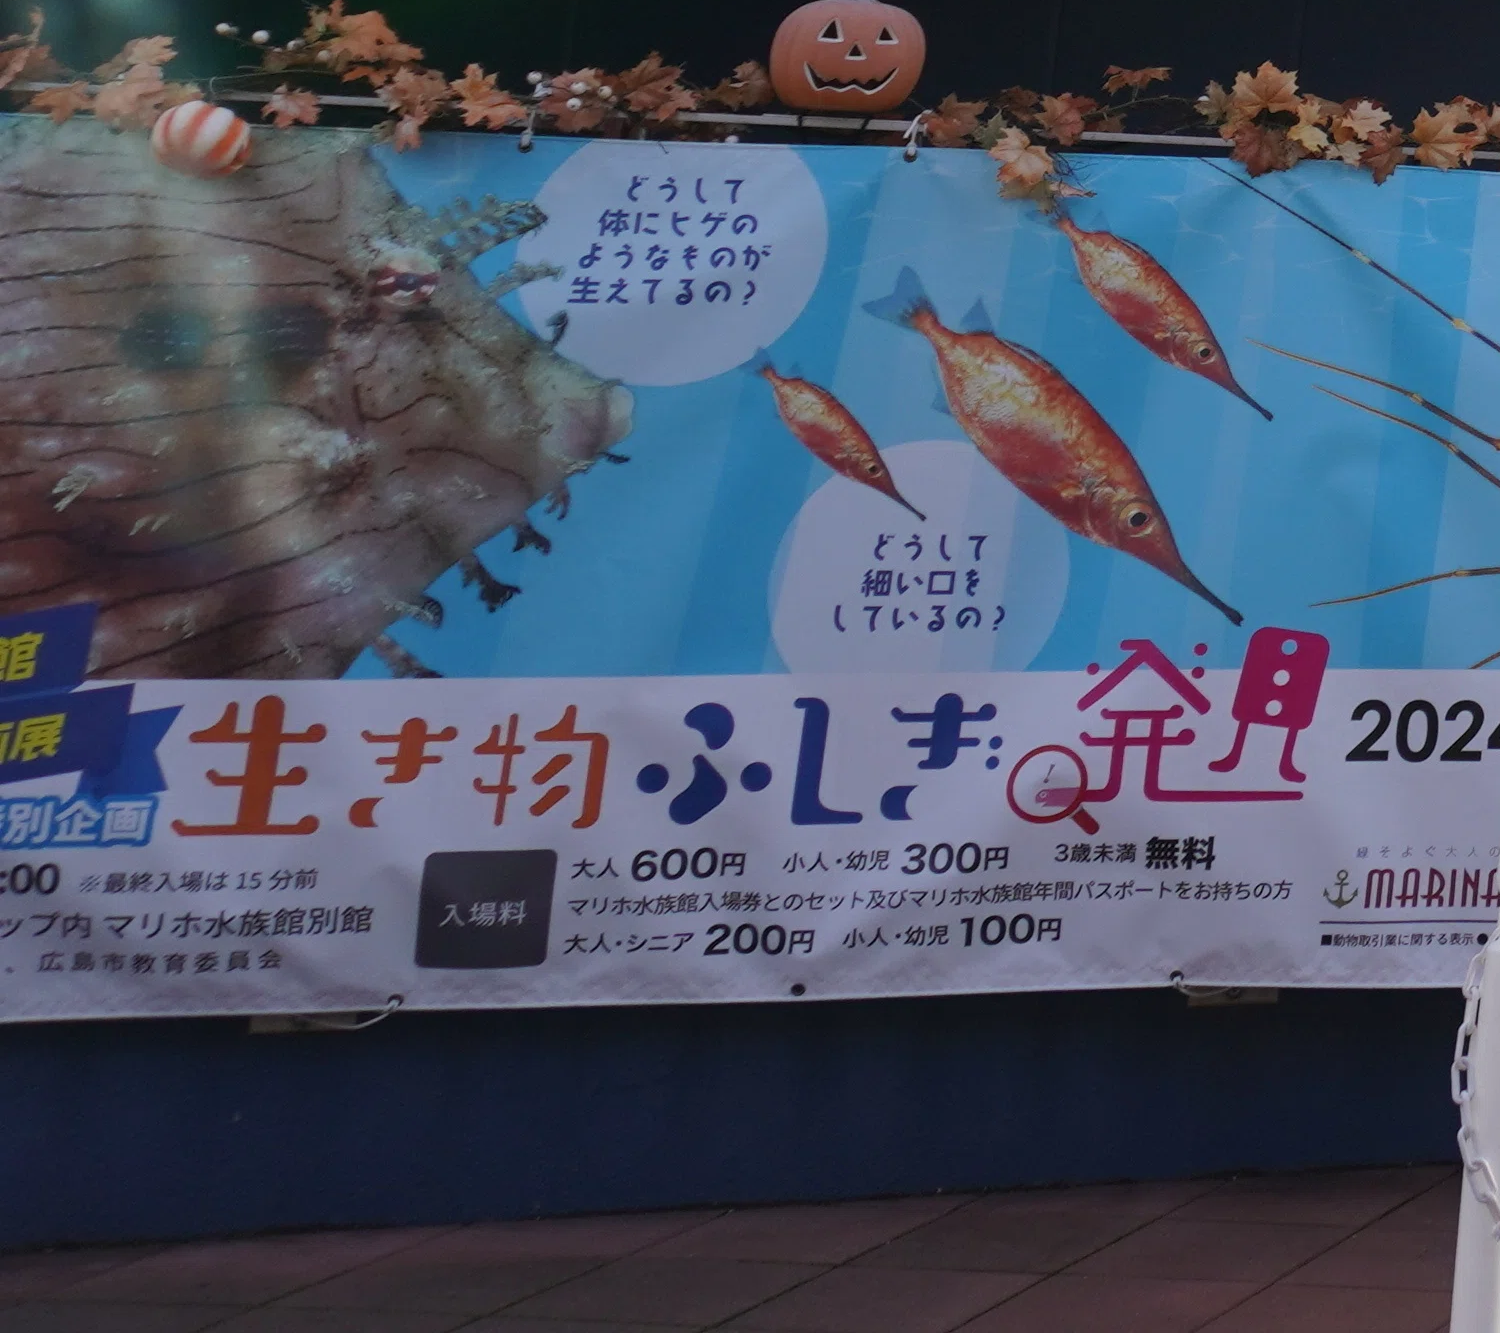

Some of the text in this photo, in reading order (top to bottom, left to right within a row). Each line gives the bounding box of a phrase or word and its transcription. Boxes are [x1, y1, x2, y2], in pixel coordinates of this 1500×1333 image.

[627, 175, 746, 204] どうして
[598, 209, 758, 237] 体にヒゲの
[578, 242, 772, 271] ようなものが
[873, 533, 989, 562] どうして
[860, 568, 980, 598] 細い口を
[0, 799, 154, 844] 別企画
[571, 858, 619, 879] 大人
[631, 847, 747, 882] 600円
[782, 850, 890, 873] 小人・幼児
[901, 842, 1009, 875] 300円
[1144, 836, 1216, 871] 無料
[103, 906, 374, 940] マリホ水族館別館
[439, 899, 527, 927] 入場料
[564, 913, 1063, 956] 大人・シニア 200円 小人・幼児 100円
